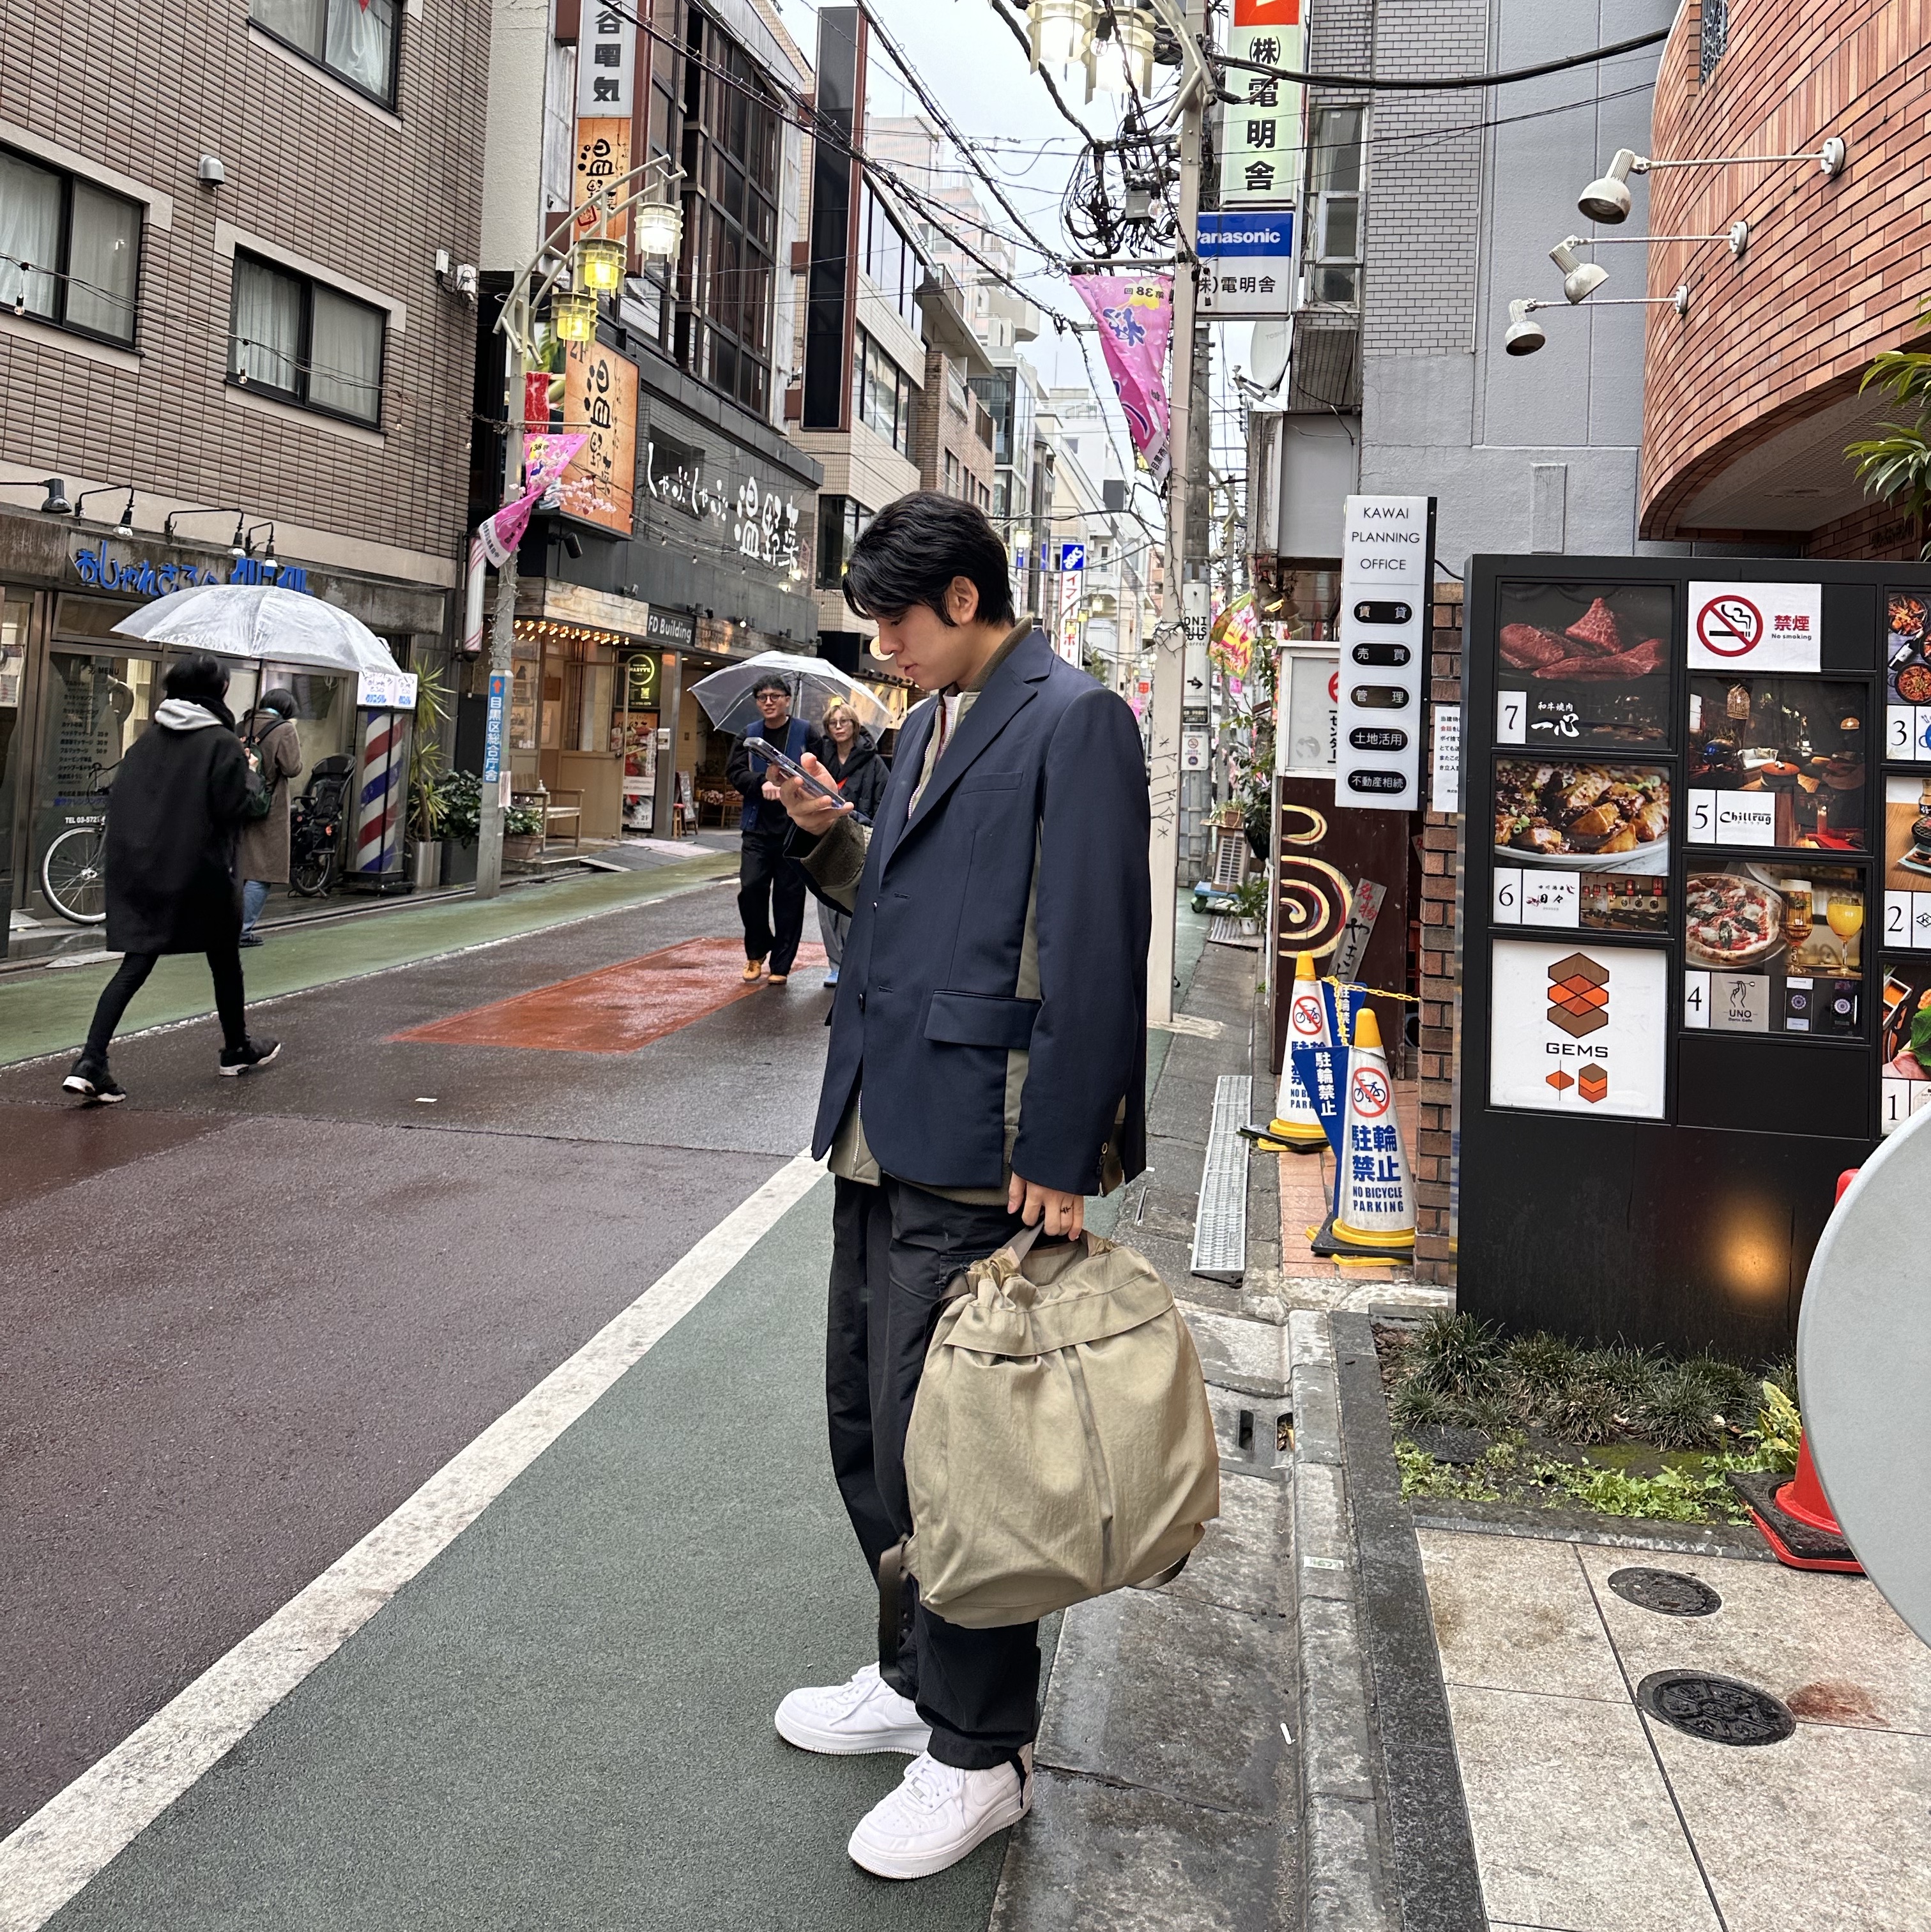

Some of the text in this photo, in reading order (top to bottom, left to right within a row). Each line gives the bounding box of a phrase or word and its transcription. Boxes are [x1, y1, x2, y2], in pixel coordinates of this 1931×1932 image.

[648, 442, 728, 521] しゃぶしゃぶ
[1364, 507, 1408, 519] KAWAI
[1352, 531, 1420, 543] PLANNING
[1361, 558, 1406, 570] OFFICE
[648, 614, 659, 632] FD
[660, 616, 692, 644] Building
[1774, 615, 1810, 631] 禁煙
[1505, 705, 1518, 730] 7
[485, 697, 501, 782] 目黒区総合庁舎
[1354, 732, 1402, 746] 土地活用
[1891, 720, 1907, 746] 3
[1351, 775, 1403, 789] 不動産相続
[1693, 804, 1709, 829] 5
[1499, 883, 1513, 906] 6
[1888, 906, 1904, 932] 2
[1687, 986, 1702, 1011] 4
[1729, 1010, 1752, 1018] UNO
[1546, 1042, 1608, 1058] GEMS
[1315, 1051, 1338, 1116] 駐輪禁止
[1888, 1094, 1900, 1121] 1
[1352, 1125, 1398, 1152] 駐輪
[1352, 1155, 1401, 1182] 禁止
[1353, 1186, 1403, 1199] NO BICYCLE
[1353, 1199, 1403, 1213] PARKING
